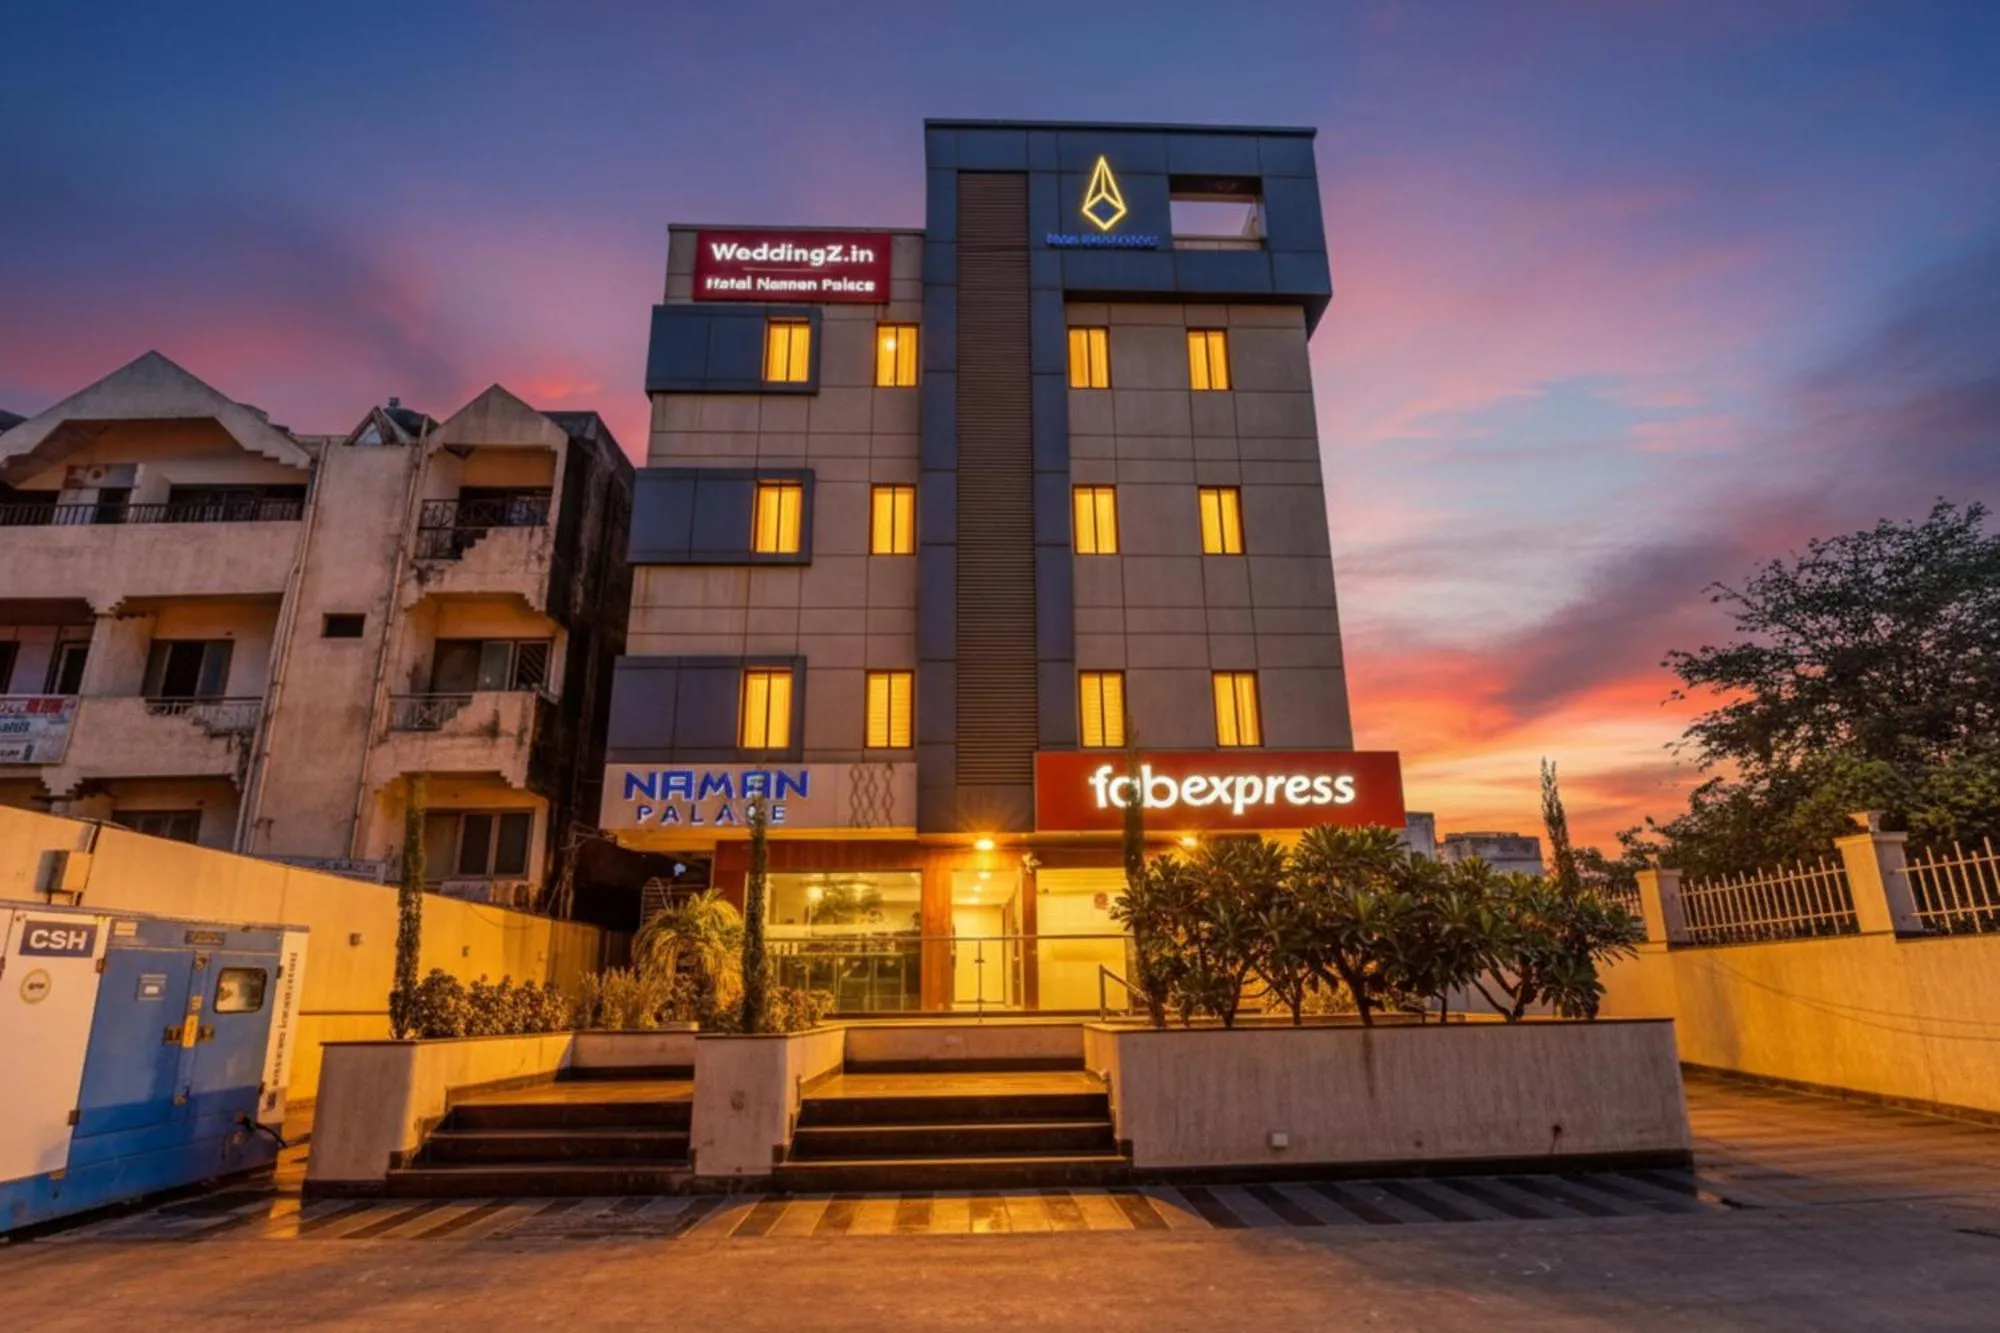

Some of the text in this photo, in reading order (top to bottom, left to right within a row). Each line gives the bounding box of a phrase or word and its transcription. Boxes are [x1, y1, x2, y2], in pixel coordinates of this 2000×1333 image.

[710, 242, 875, 267] WeddingZ.in
[623, 769, 810, 801] NAMAN
[1088, 763, 1357, 815] fabexpress
[28, 928, 89, 951] CSH
